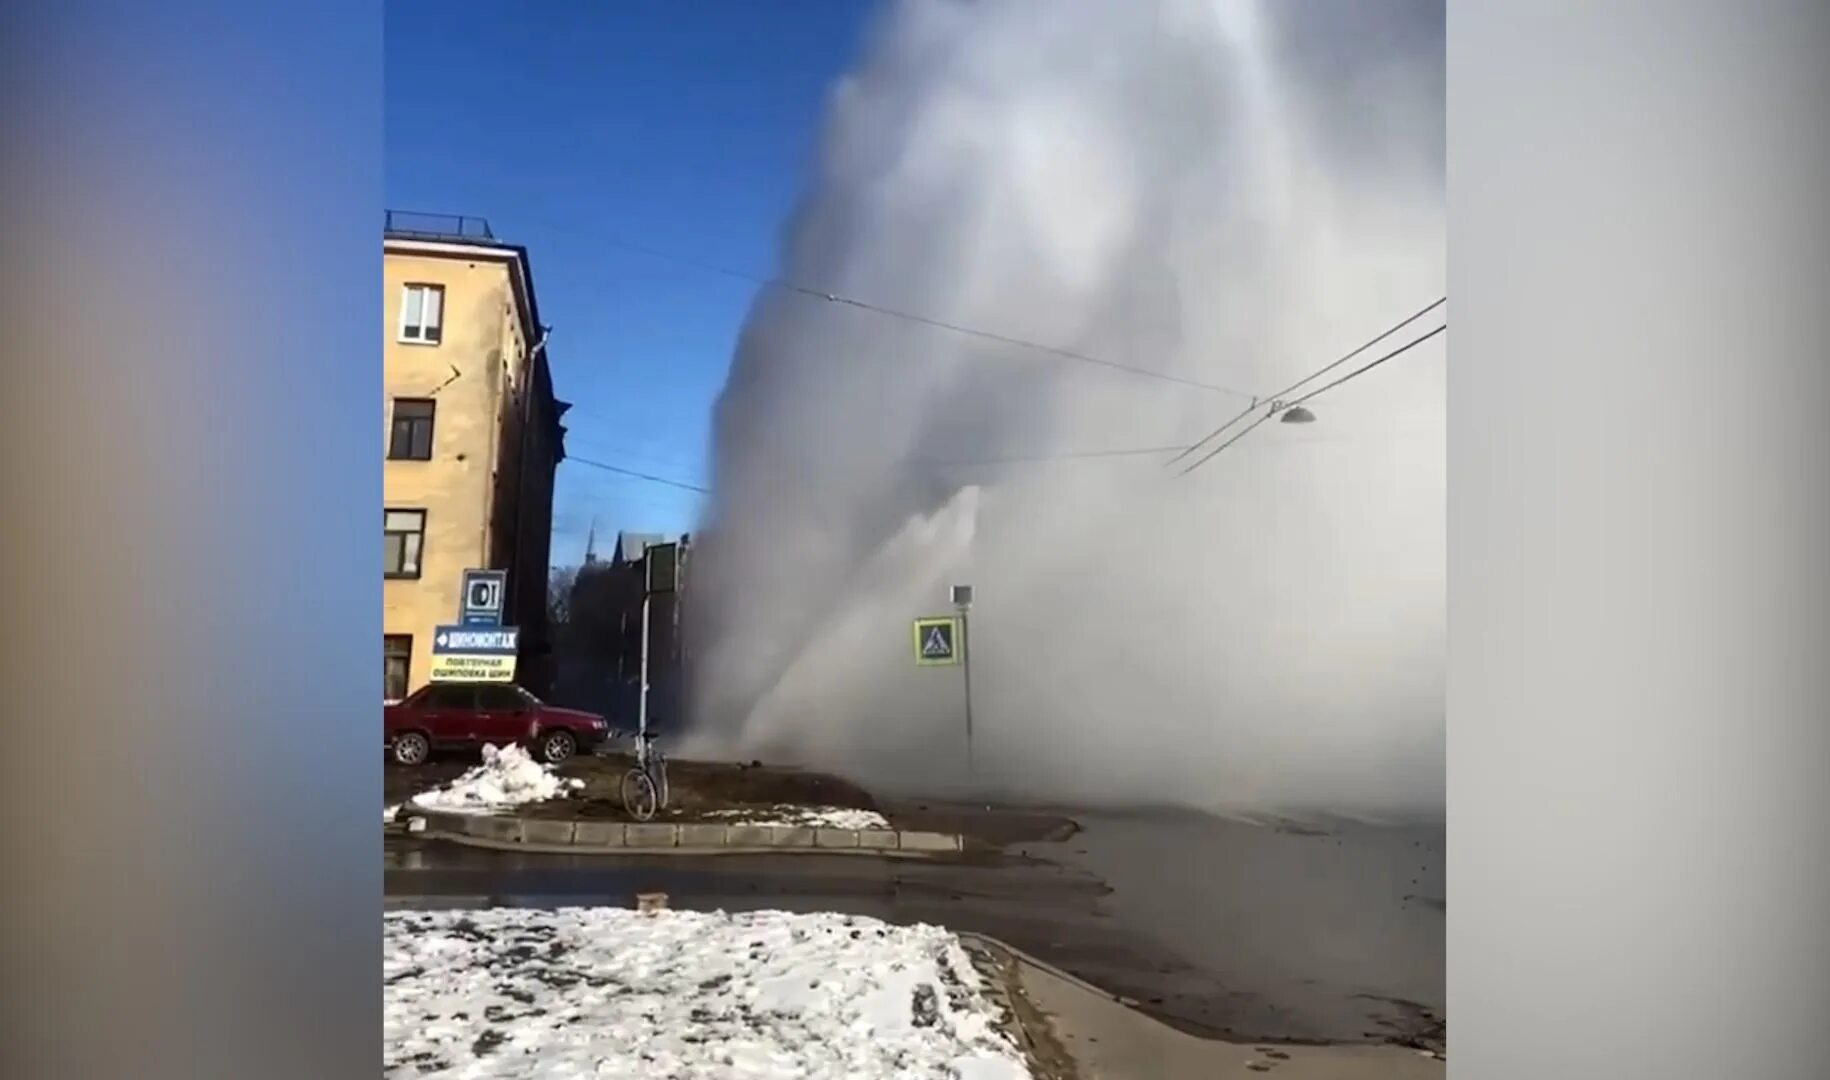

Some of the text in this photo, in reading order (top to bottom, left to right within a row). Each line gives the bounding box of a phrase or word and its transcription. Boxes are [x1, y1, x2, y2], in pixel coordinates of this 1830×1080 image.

[448, 631, 517, 649] ШИНОМОНТАЖ
[445, 657, 502, 667] ПОВТОРНАЯ
[433, 668, 511, 678] ОШИПОВКА ШИН
